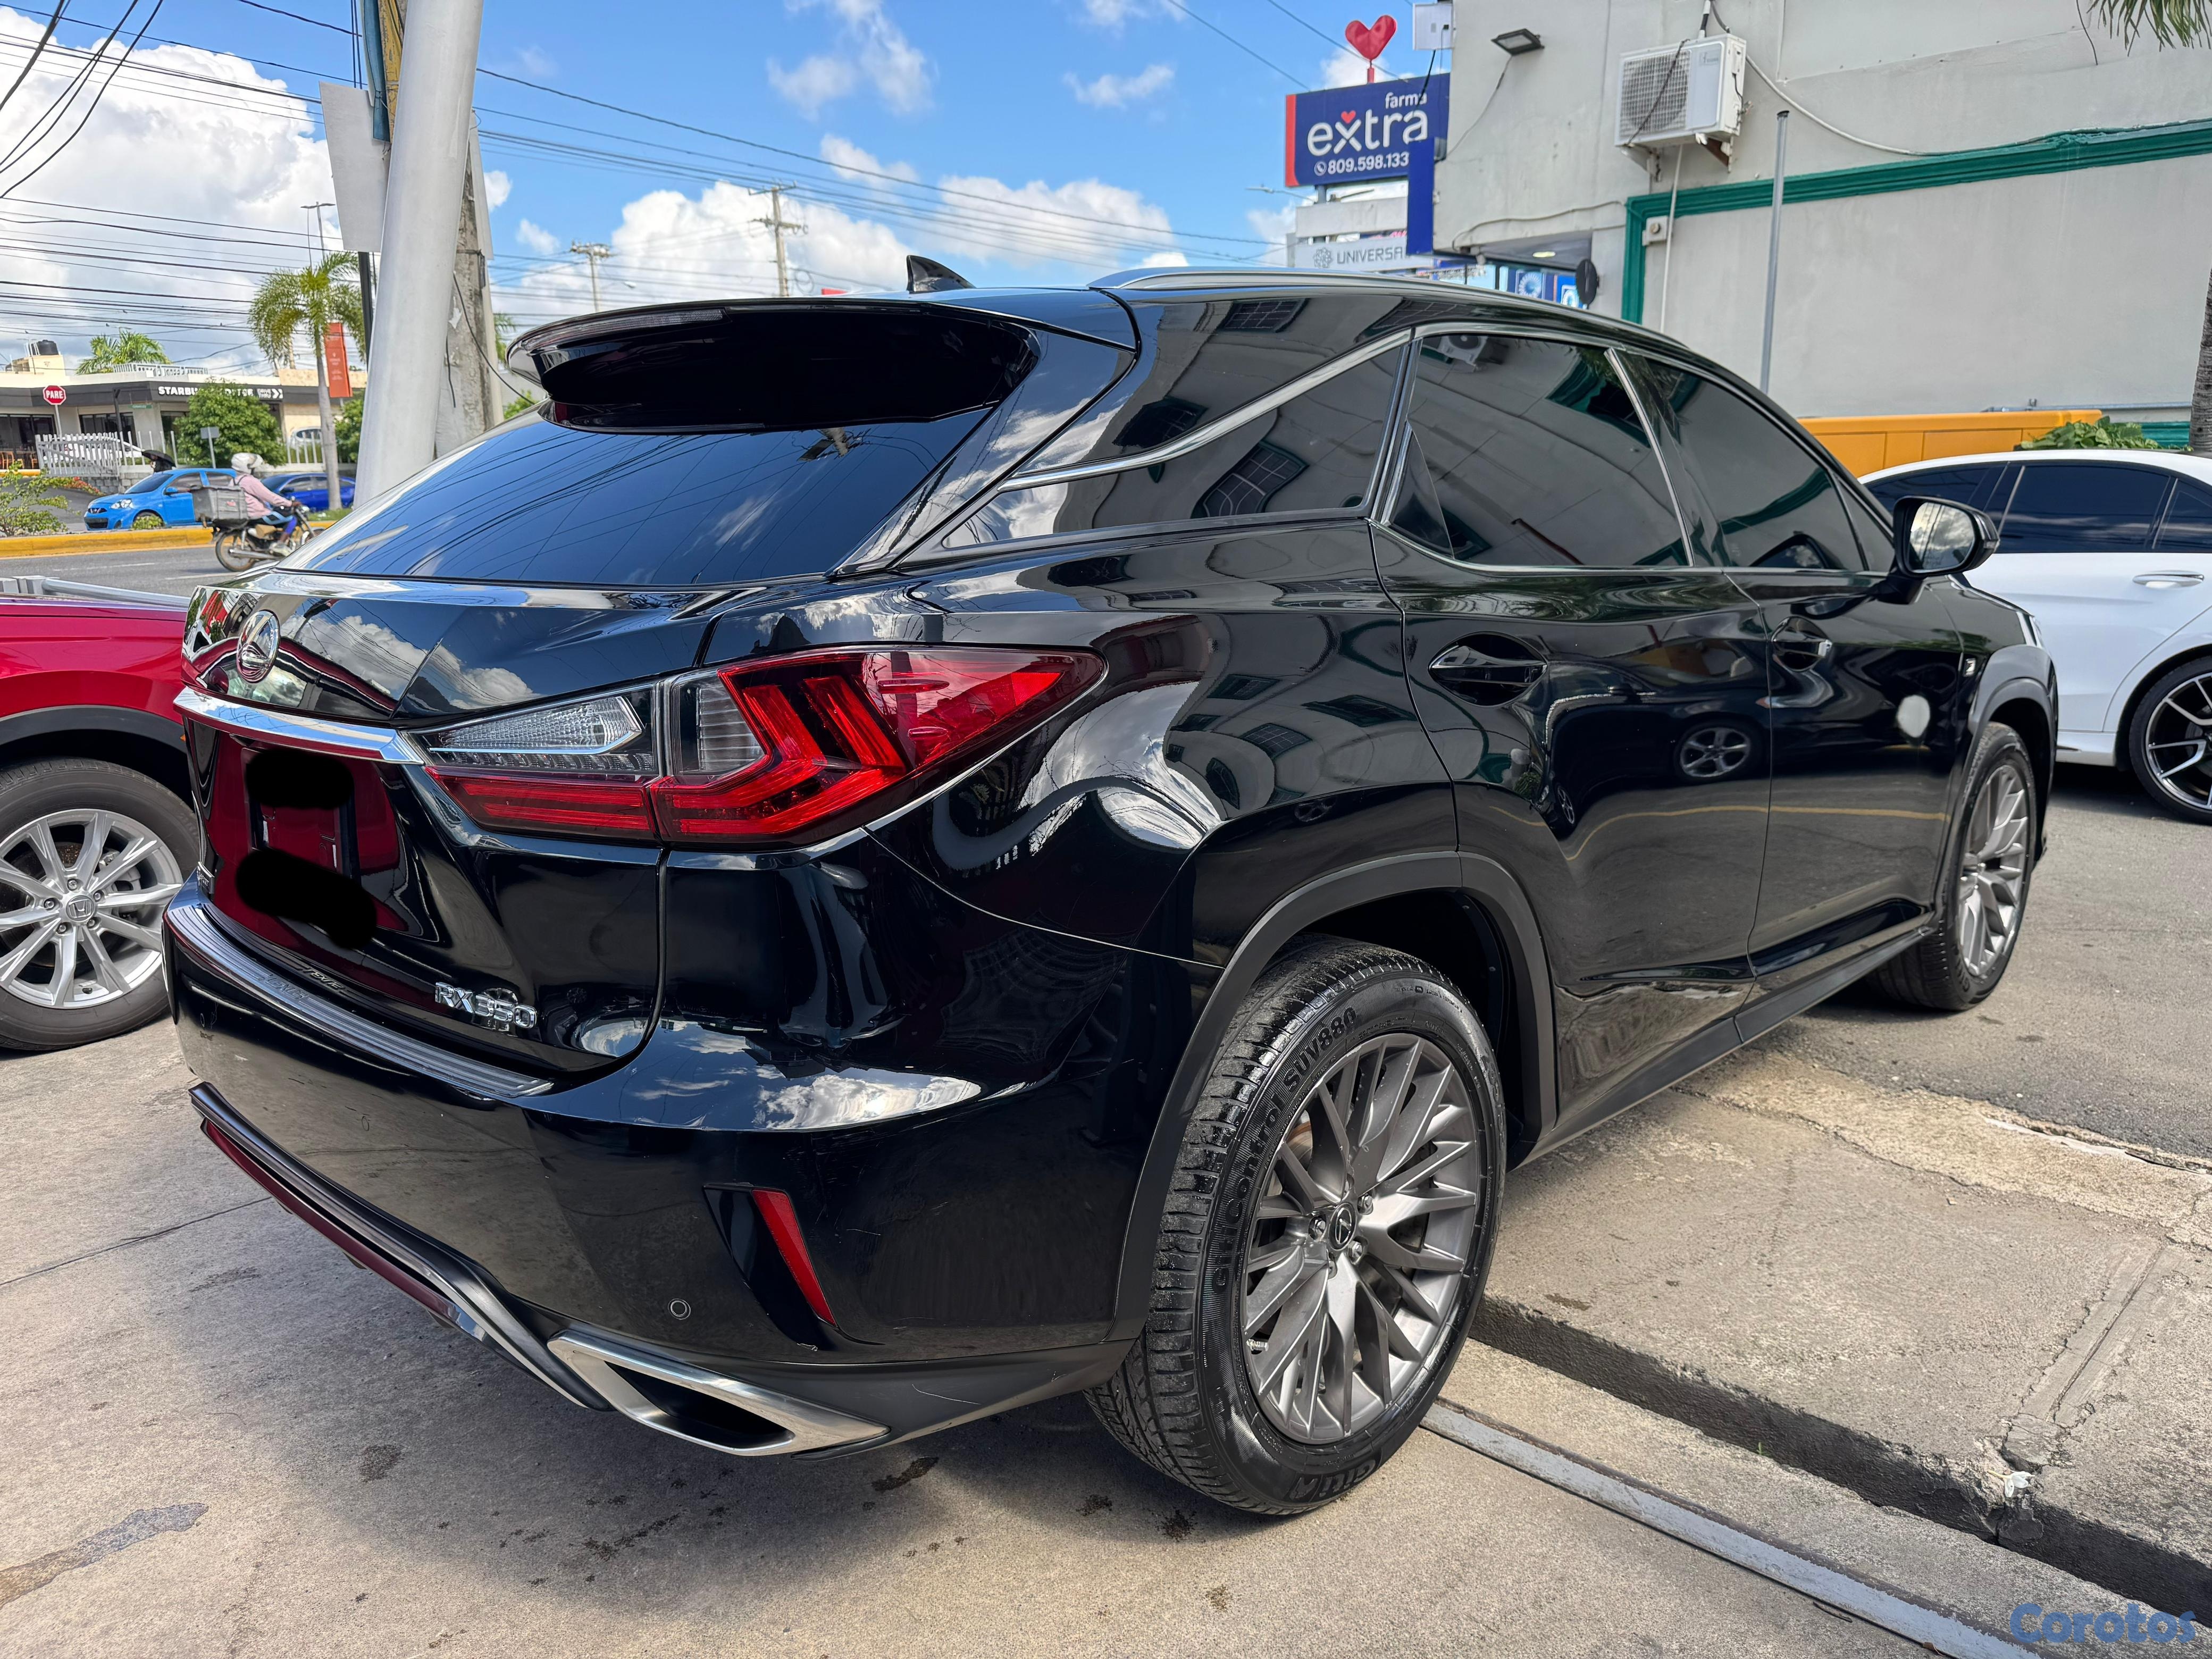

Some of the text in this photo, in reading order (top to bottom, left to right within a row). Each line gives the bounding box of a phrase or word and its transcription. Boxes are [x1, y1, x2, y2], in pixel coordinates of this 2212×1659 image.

[1385, 92, 1427, 109] farma
[1307, 109, 1428, 156] extra
[1328, 152, 1410, 174] 809.598.133
[1337, 247, 1407, 264] UNIVERSA
[46, 390, 64, 399] PARE
[158, 387, 198, 396] STARBU
[1283, 1006, 1356, 1094] SUV880
